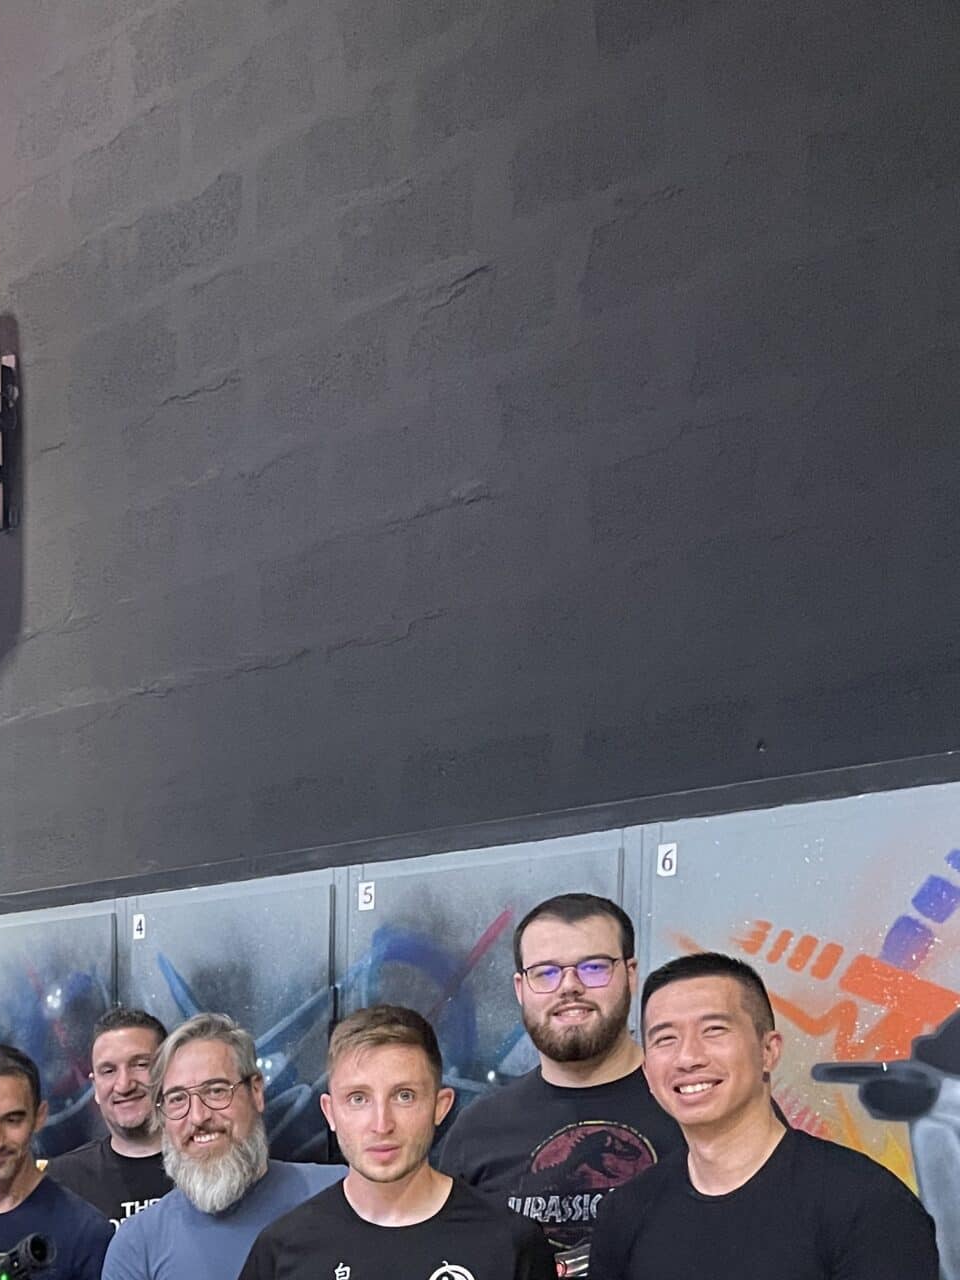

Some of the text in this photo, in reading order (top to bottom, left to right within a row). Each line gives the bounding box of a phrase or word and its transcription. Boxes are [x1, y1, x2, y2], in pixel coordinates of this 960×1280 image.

[661, 848, 674, 872] 6
[363, 885, 373, 905] 5
[135, 918, 144, 936] 4
